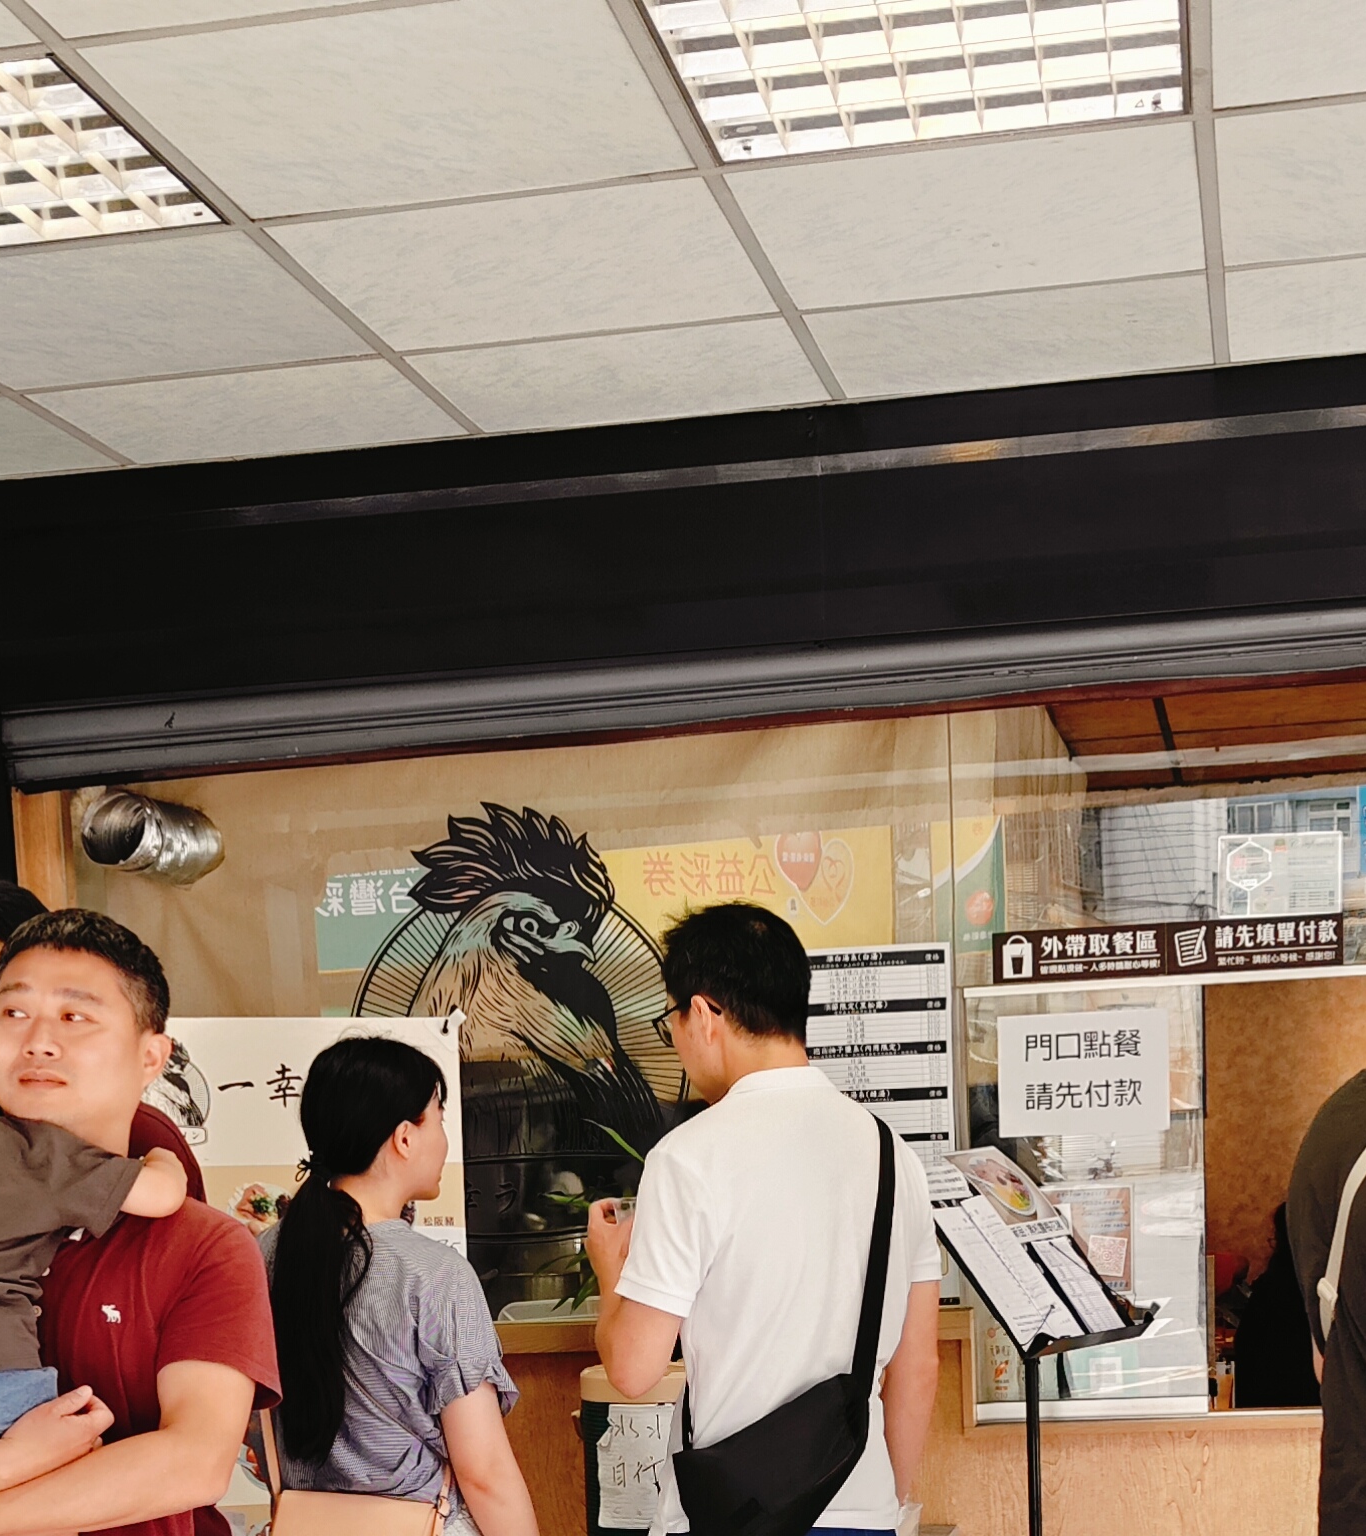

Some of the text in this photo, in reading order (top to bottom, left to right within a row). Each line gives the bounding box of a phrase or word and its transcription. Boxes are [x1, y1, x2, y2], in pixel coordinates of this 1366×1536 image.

[1040, 930, 1158, 958] 外帶取餐區
[1215, 920, 1338, 948] 請先填單付款
[1025, 1029, 1142, 1062] 門口點餐
[218, 1063, 303, 1108] 一幸
[1025, 1078, 1142, 1110] 請先付款
